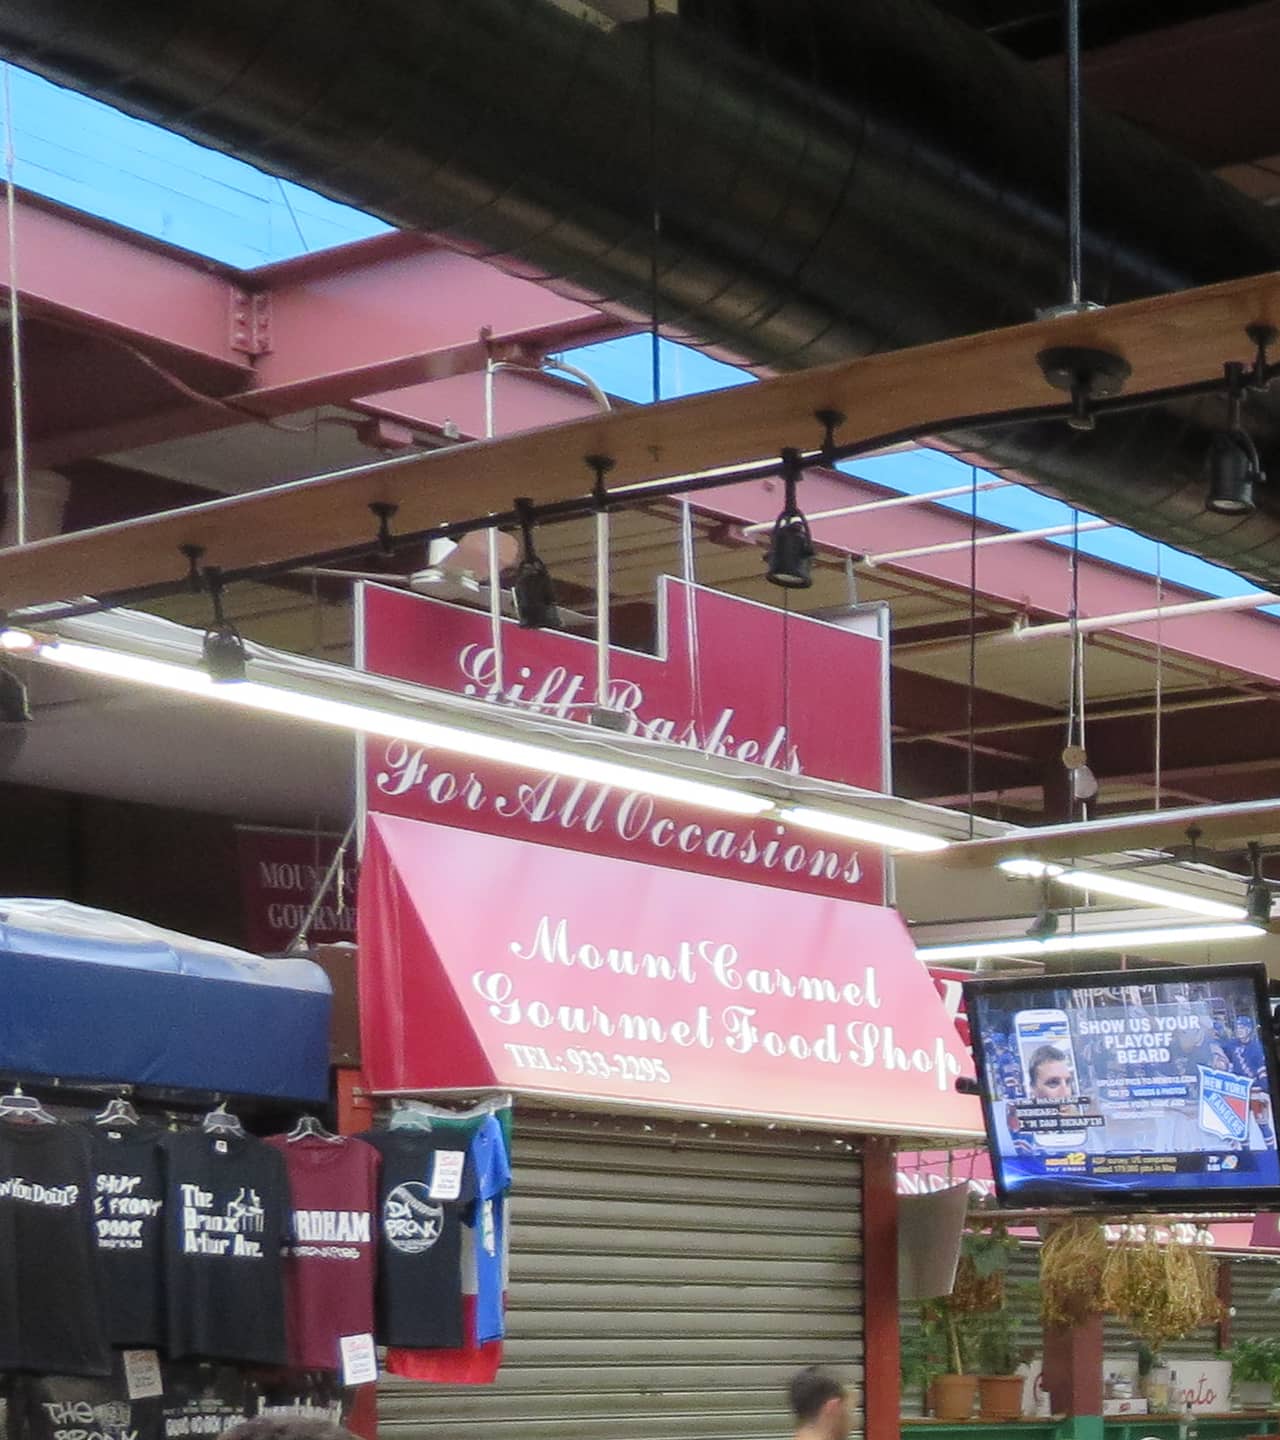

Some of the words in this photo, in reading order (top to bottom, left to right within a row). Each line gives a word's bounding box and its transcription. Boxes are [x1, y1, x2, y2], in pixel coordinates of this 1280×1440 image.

[377, 738, 488, 812] For
[496, 774, 605, 834] All
[616, 790, 864, 885] Occasions
[510, 916, 696, 984] Mount
[699, 940, 880, 1008] Carmel
[472, 970, 713, 1048] Gourmet
[722, 1005, 840, 1064] Food
[847, 1021, 960, 1090] Shop
[1080, 1019, 1125, 1035] SHOW
[1130, 1018, 1152, 1033] US
[1155, 1015, 1201, 1031] YOUR
[1104, 1032, 1173, 1049] PLAYOFF
[1117, 1048, 1170, 1064] BEARD
[1203, 1076, 1222, 1090] NEW
[1224, 1081, 1248, 1096] YORK
[181, 1184, 214, 1207] The
[292, 1210, 371, 1243] RDHAM
